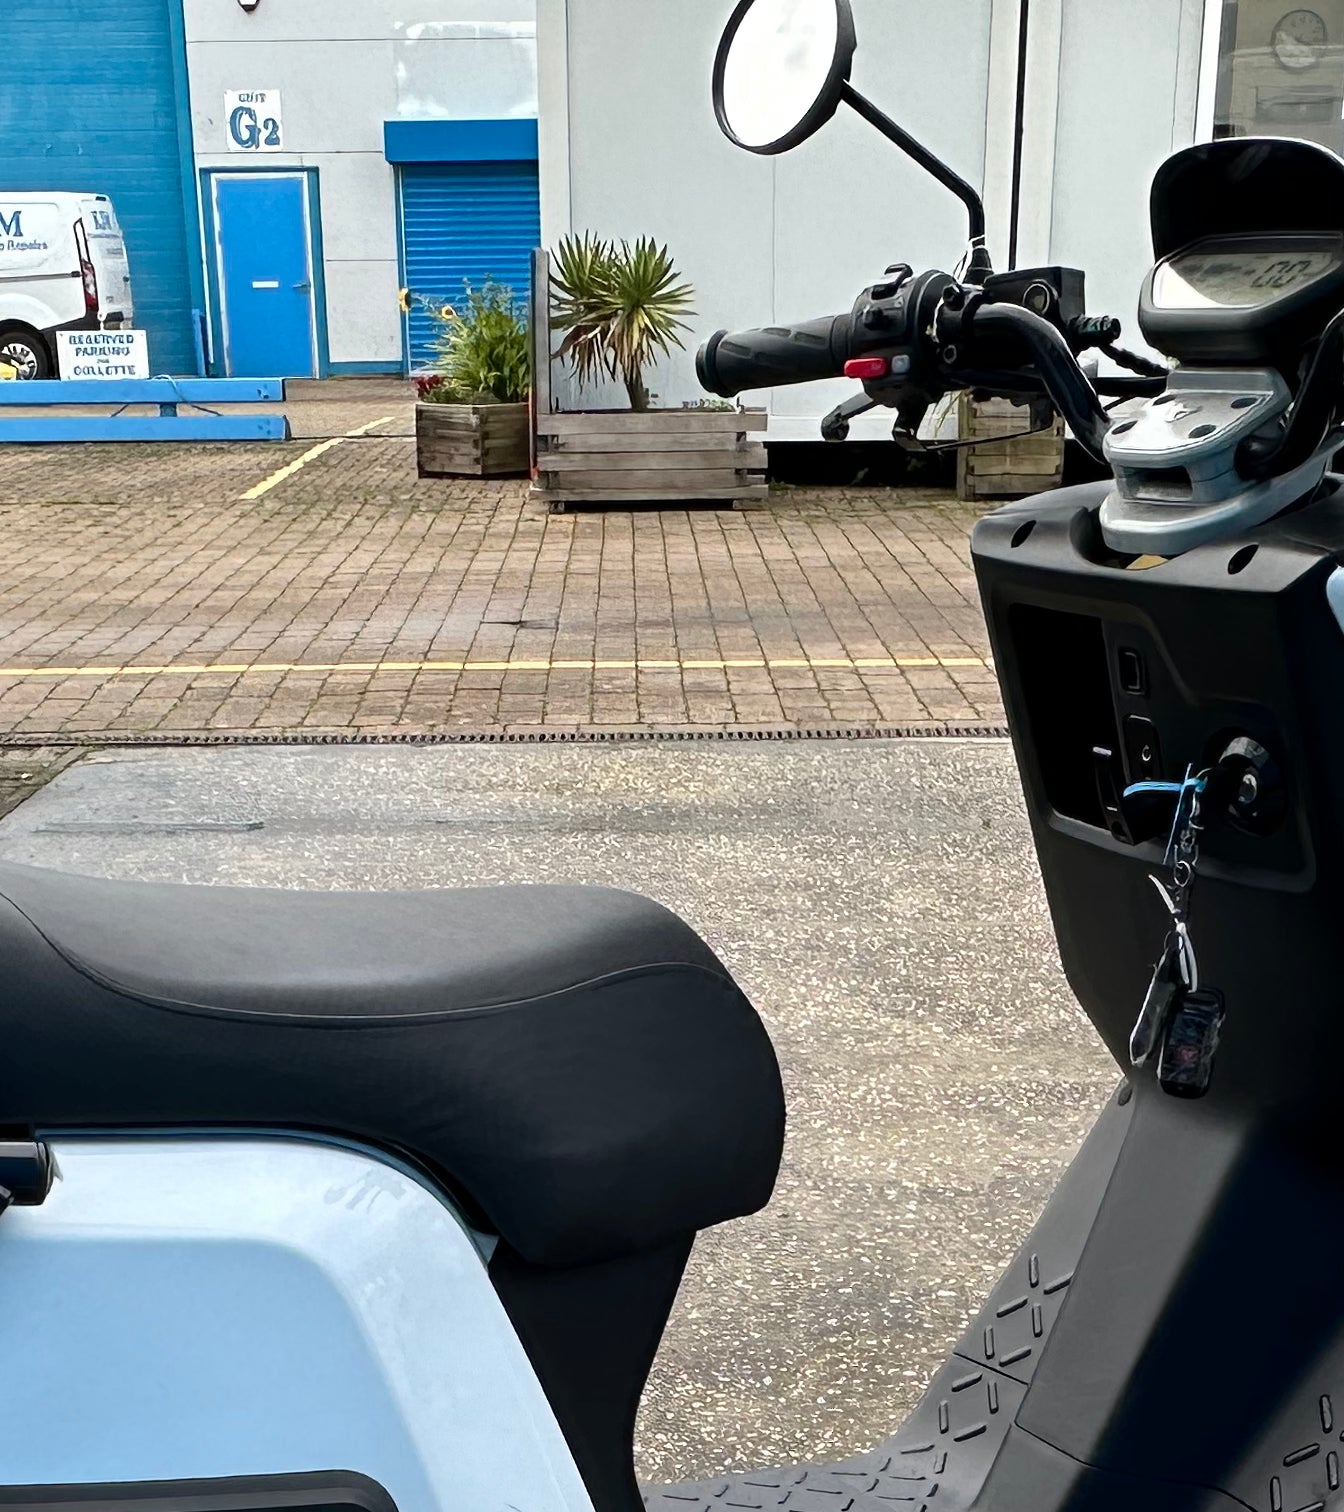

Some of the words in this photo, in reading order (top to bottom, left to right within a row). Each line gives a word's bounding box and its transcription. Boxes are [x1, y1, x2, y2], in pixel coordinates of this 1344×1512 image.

[229, 105, 281, 150] G2
[69, 334, 135, 345] RESERVED
[75, 346, 130, 357] PARKING
